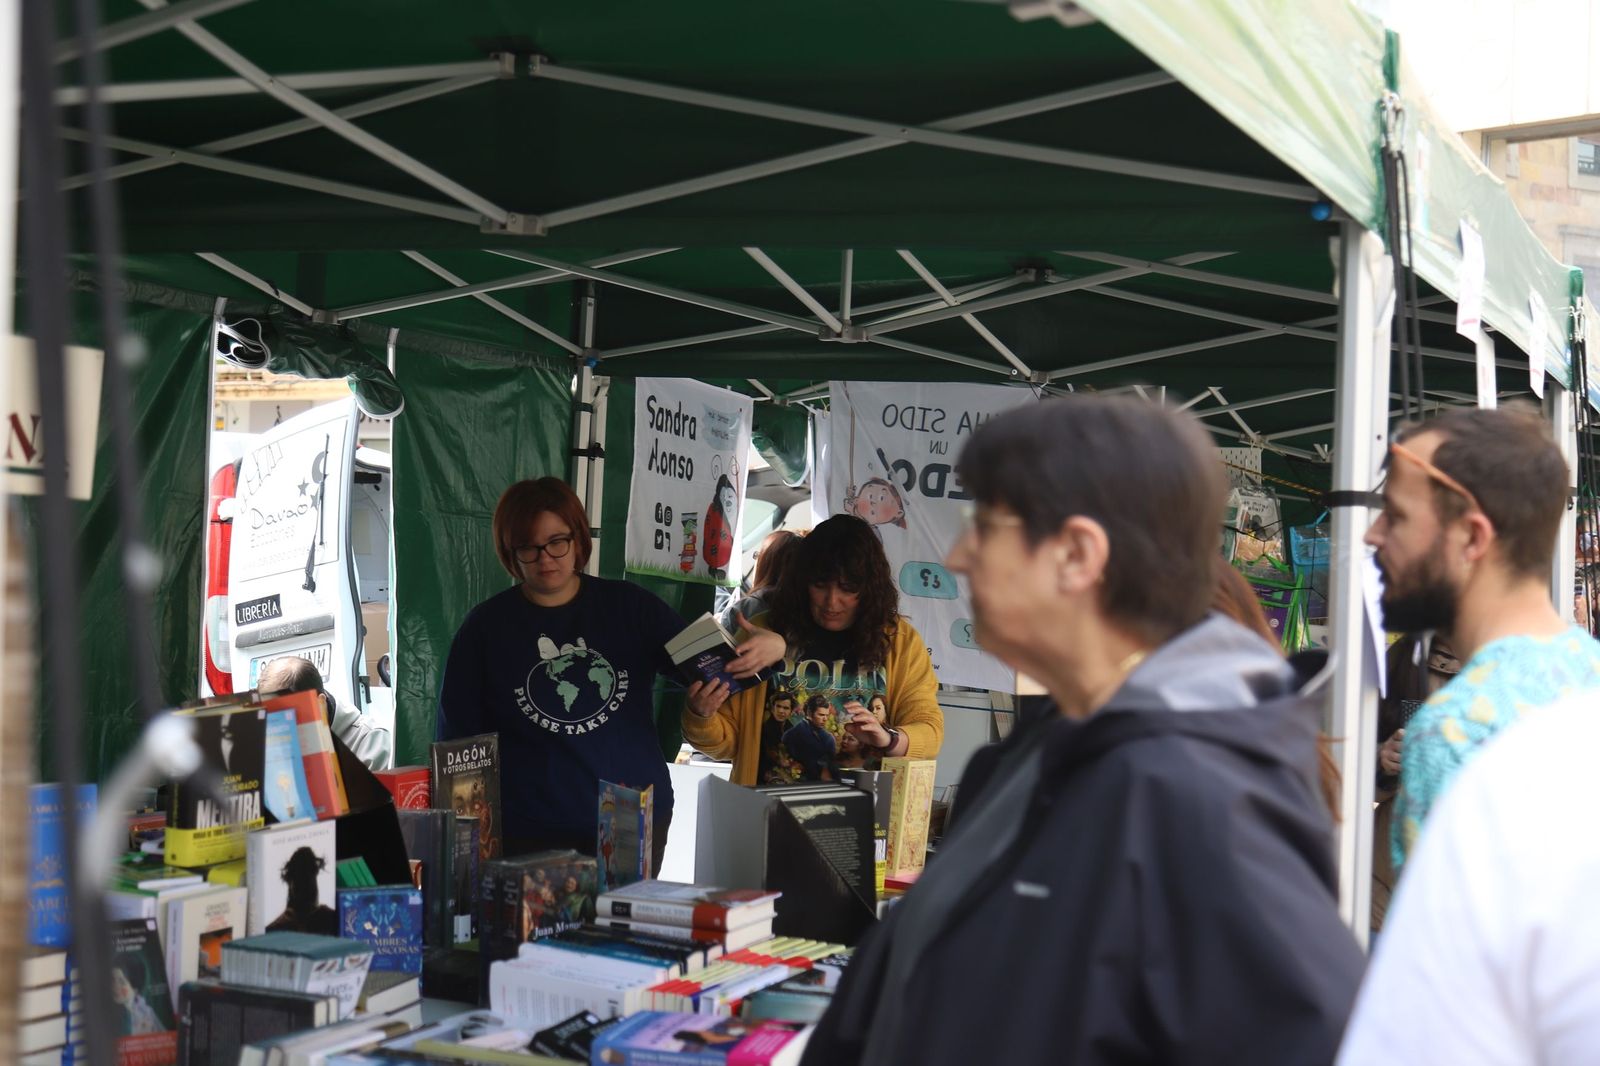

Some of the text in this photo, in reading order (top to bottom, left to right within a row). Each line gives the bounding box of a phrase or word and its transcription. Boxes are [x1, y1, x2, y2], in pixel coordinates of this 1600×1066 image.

[647, 395, 696, 440] Sandra
[6, 412, 45, 465] N
[237, 599, 280, 624] LIBRERÍA
[514, 669, 629, 735] PLEASE TAKE CARE
[443, 767, 447, 775] Y
[447, 763, 467, 774] OTROS
[467, 758, 491, 770] RELATOS
[447, 744, 486, 766] DAGÓN
[532, 926, 553, 940] Juan
